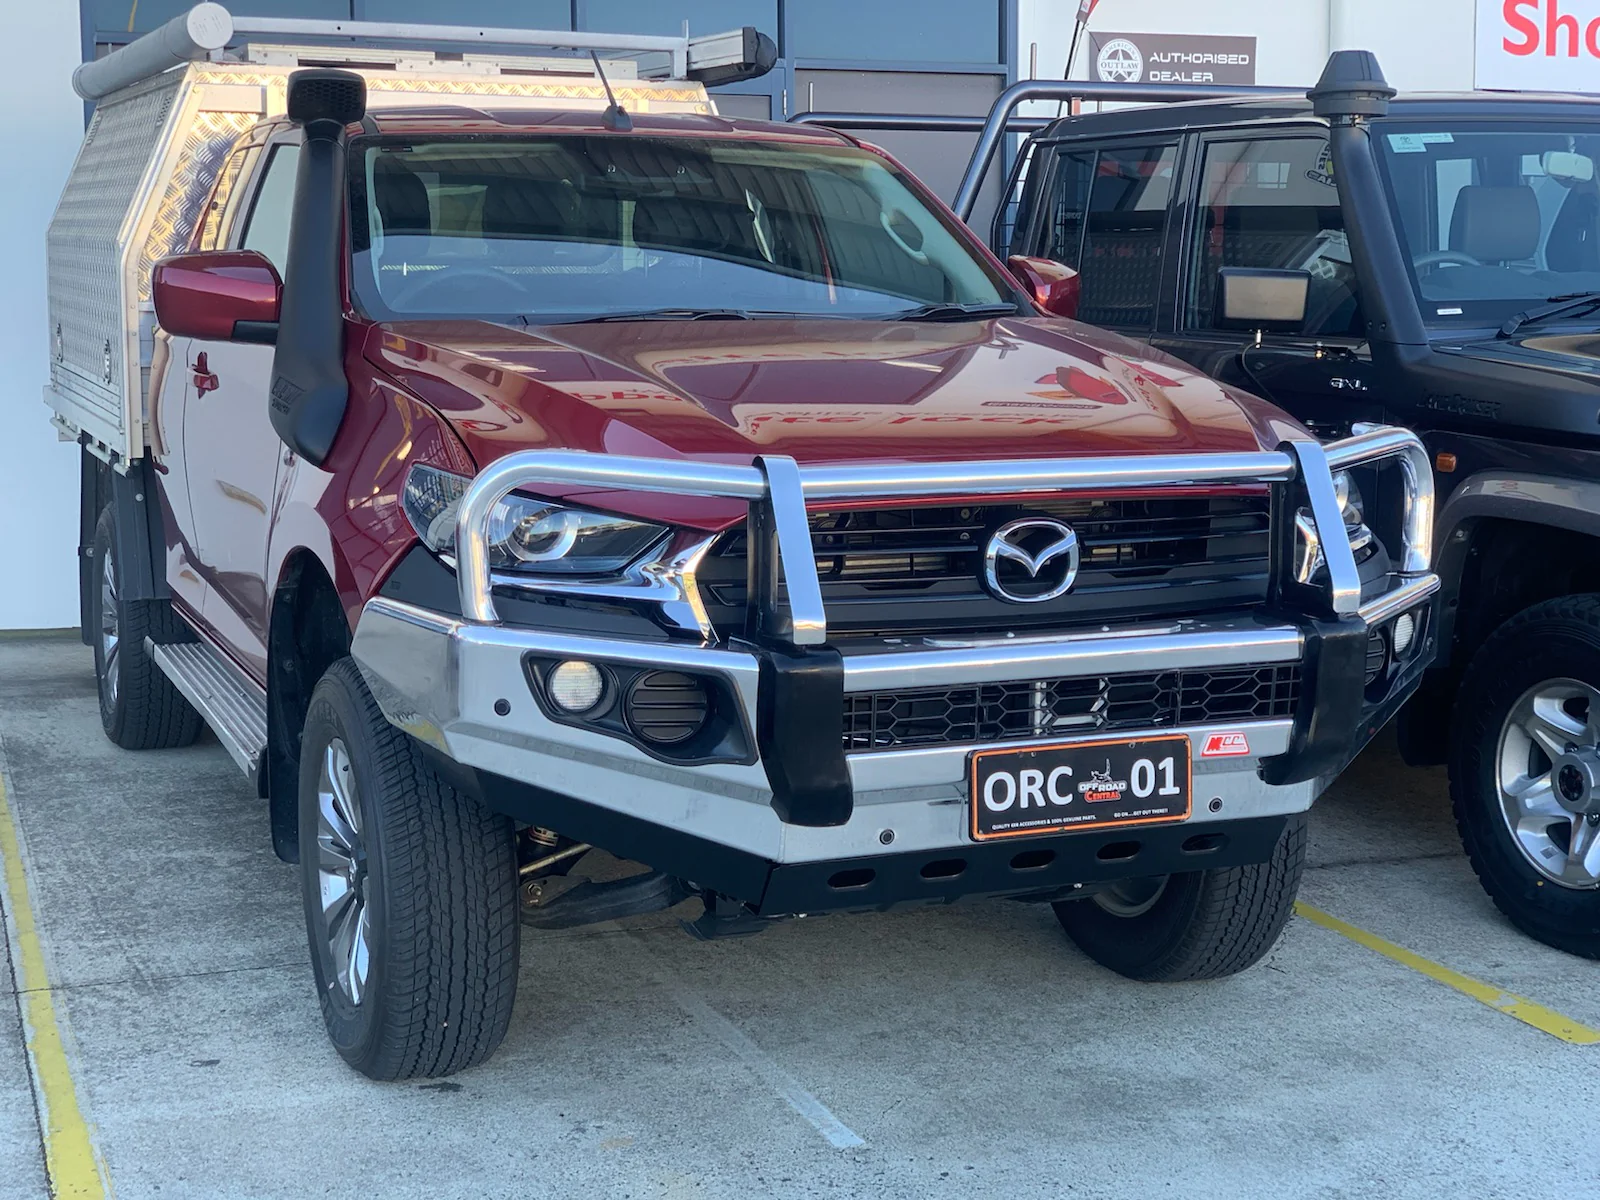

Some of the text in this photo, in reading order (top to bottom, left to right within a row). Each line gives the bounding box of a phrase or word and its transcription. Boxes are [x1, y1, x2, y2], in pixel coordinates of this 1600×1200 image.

[1149, 52, 1250, 65] AUTHORISED
[1100, 61, 1139, 69] OUTLAW
[1149, 71, 1214, 83] DEALER
[1329, 377, 1368, 391] GXL
[983, 756, 1181, 812] ORC 01
[1019, 819, 1046, 827] ACCESSORIES
[1063, 815, 1082, 823] GENUINE
